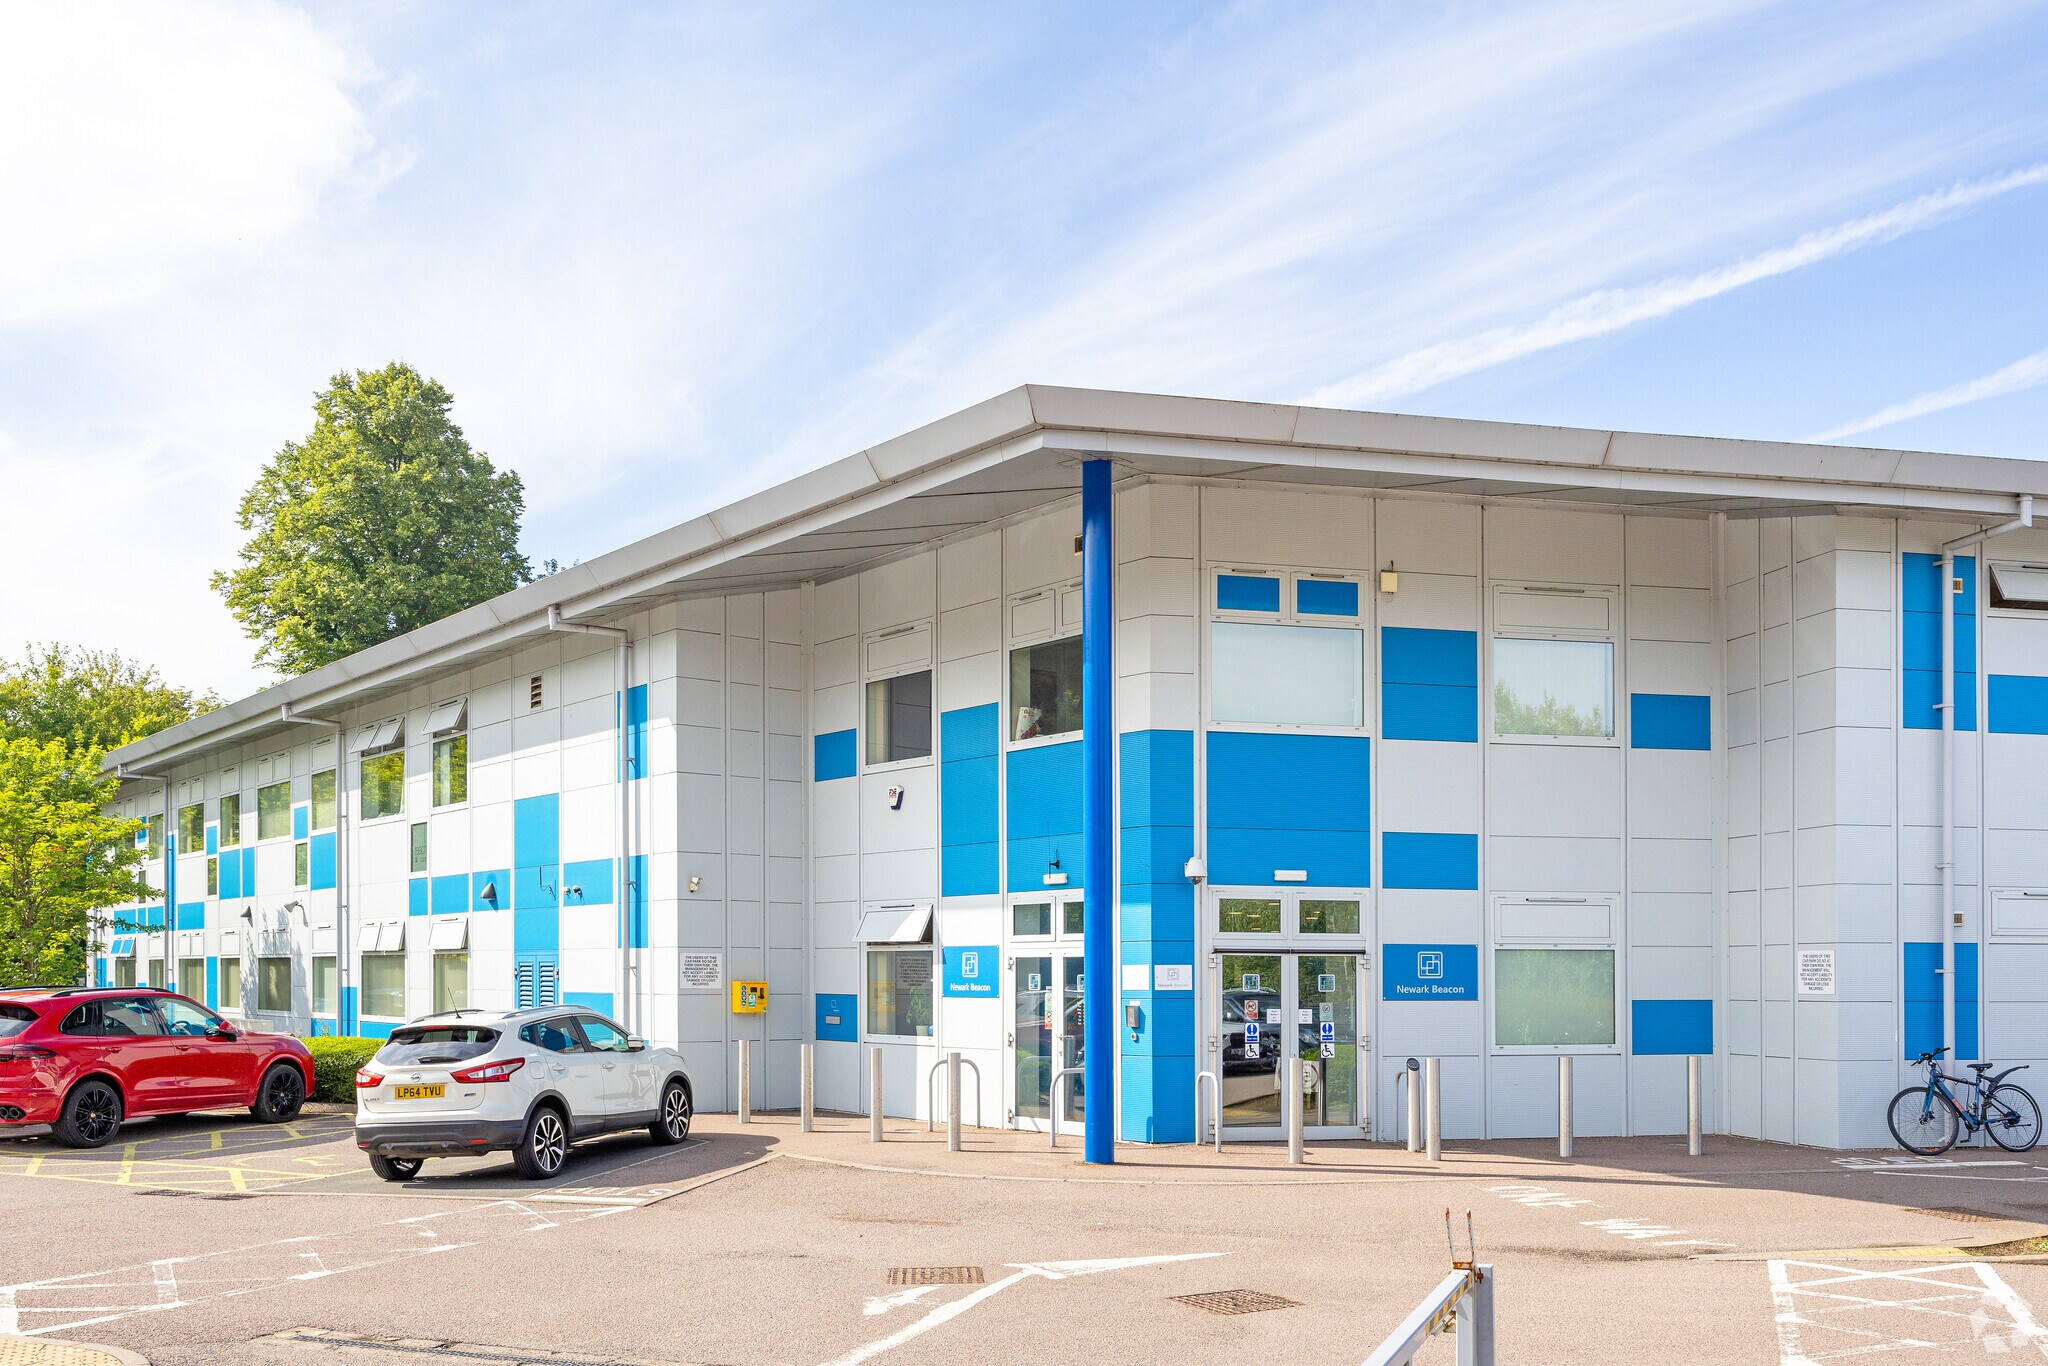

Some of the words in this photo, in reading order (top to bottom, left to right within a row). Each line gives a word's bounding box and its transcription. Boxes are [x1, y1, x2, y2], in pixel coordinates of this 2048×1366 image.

[950, 983, 969, 991] Newark
[970, 983, 991, 991] Beacon
[1397, 985, 1429, 993] Newark
[1432, 985, 1464, 993] Beacon
[398, 1088, 420, 1098] LP64
[423, 1086, 441, 1096] TVU
[555, 1186, 673, 1197] STOP
